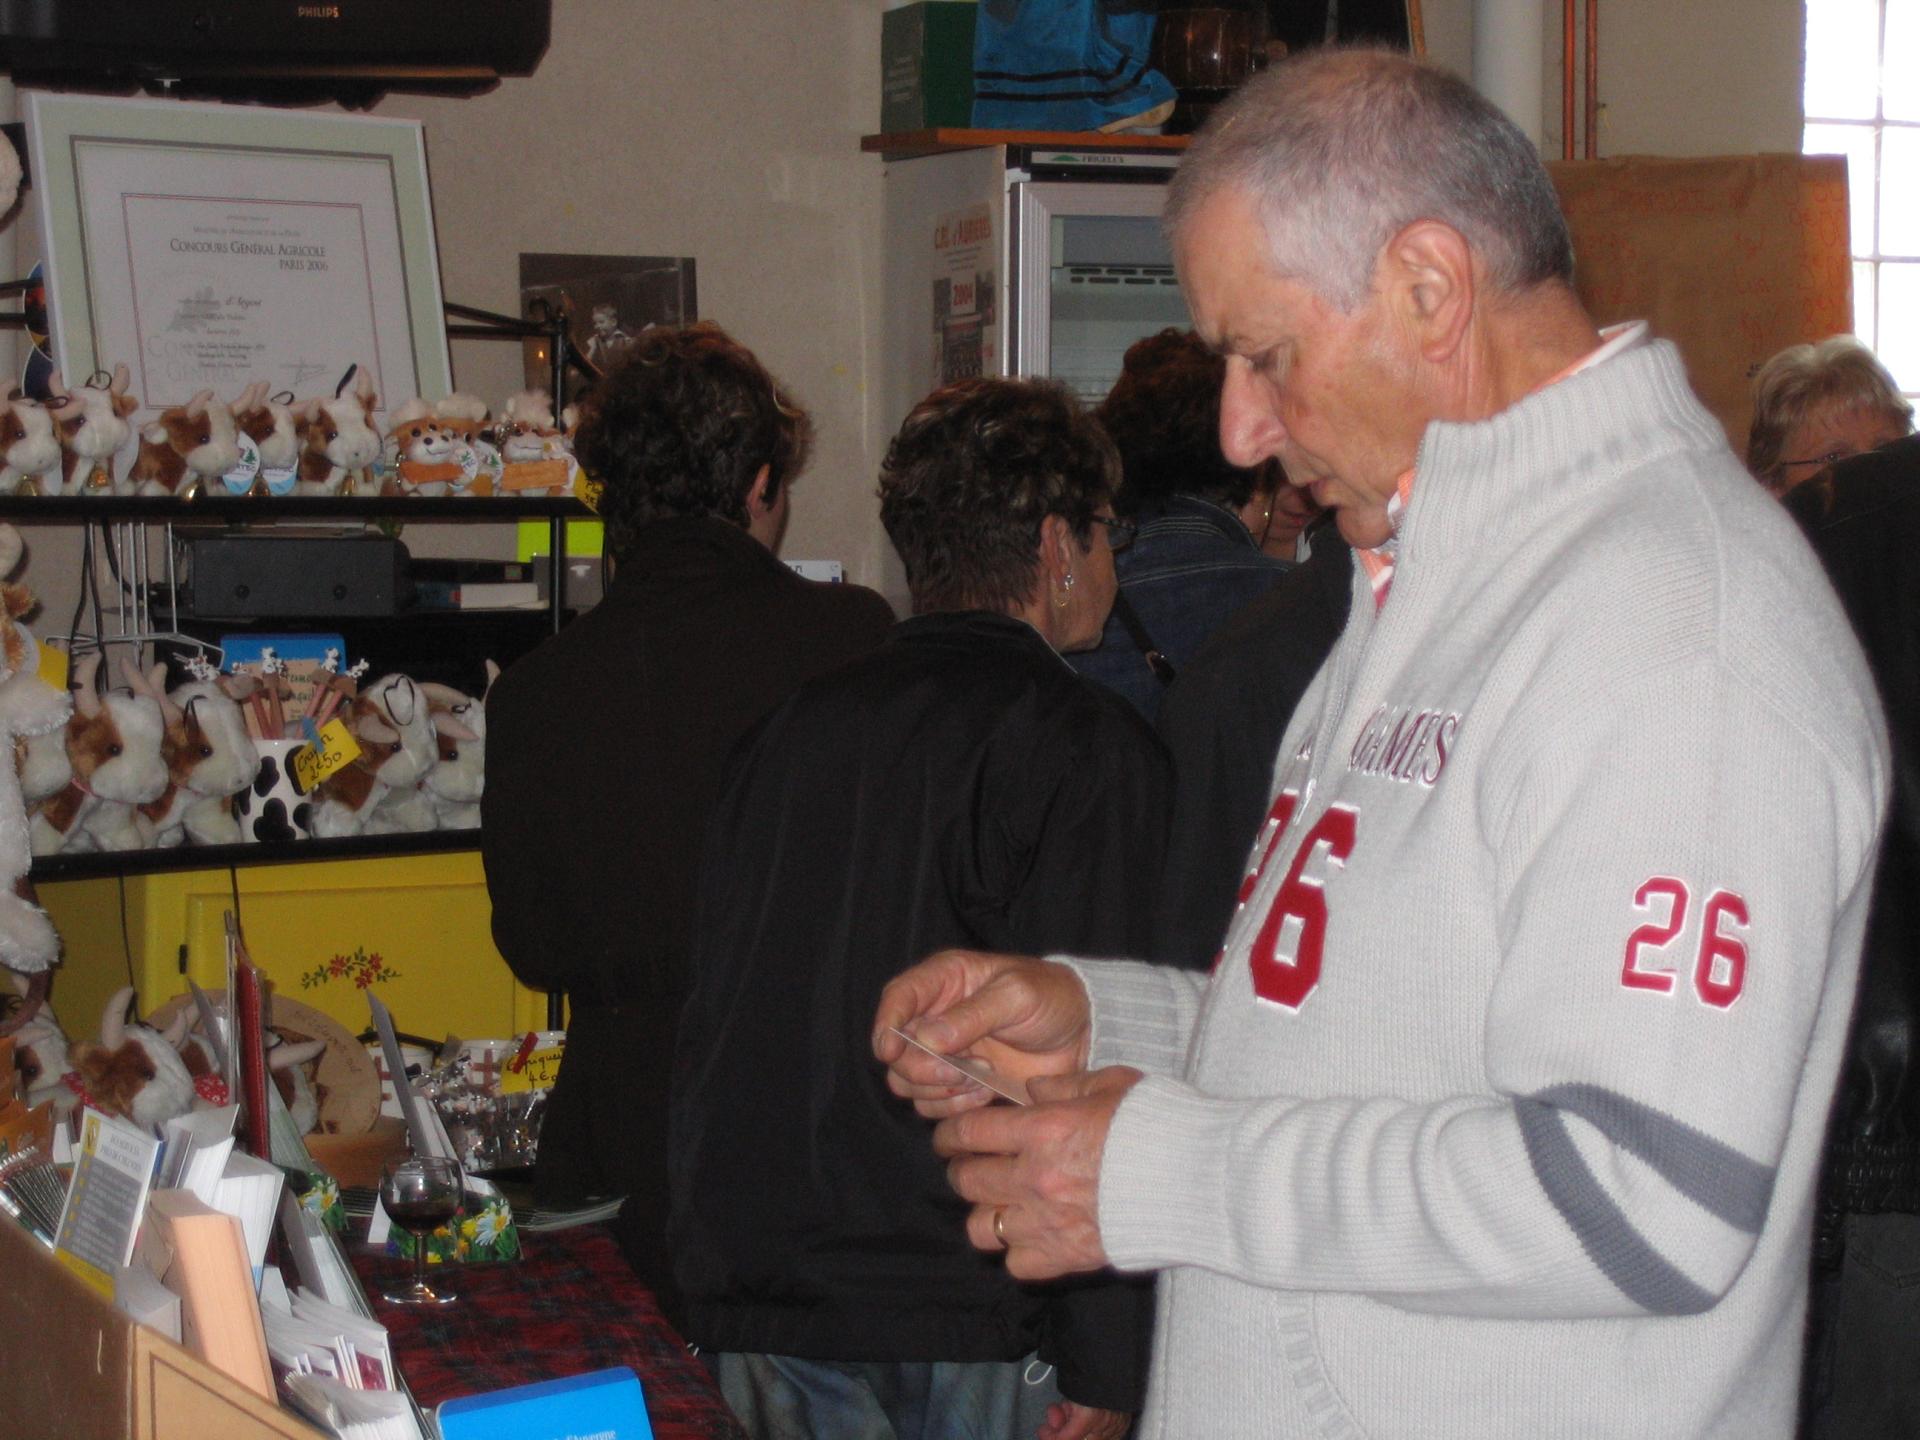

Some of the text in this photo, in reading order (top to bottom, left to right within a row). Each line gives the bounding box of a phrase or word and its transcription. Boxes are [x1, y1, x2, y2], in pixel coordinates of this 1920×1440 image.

[298, 6, 340, 18] PHILIPS
[170, 238, 229, 254] CONCOURS
[278, 243, 326, 257] AGRICOLE
[279, 259, 328, 272] PARIS 2006
[1347, 702, 1463, 789] GAMES
[1620, 874, 1751, 1013] 26
